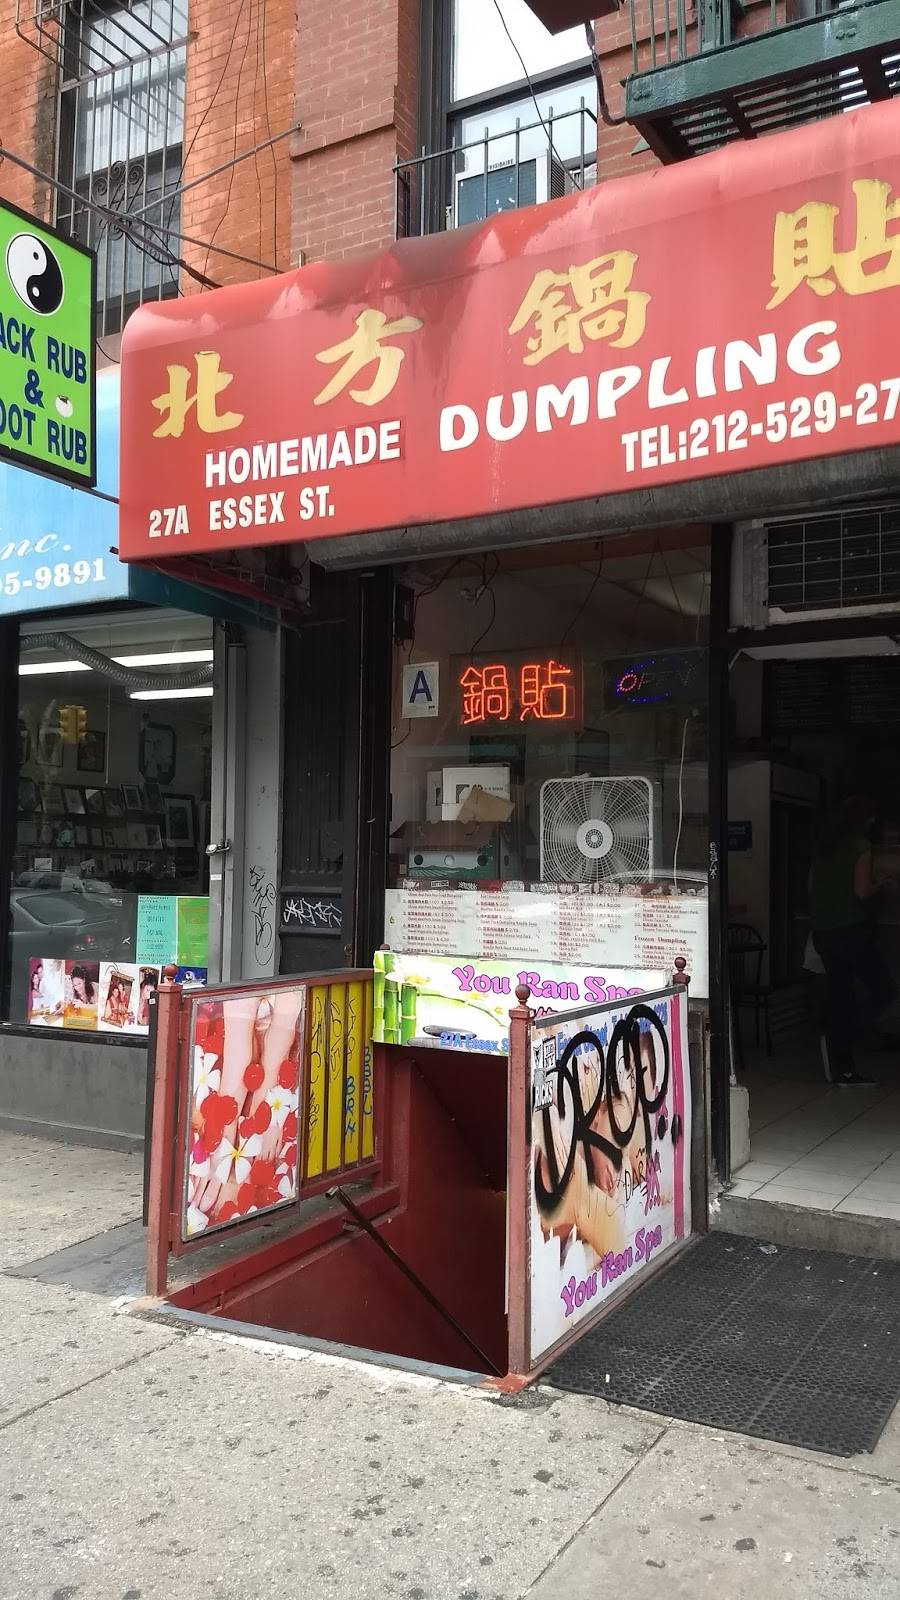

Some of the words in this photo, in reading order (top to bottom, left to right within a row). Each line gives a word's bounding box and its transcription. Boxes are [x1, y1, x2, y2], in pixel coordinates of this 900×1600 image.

[47, 335, 87, 385] RUB
[24, 369, 45, 409] &
[204, 420, 401, 488] HOMEMADE
[439, 320, 842, 452] DUMPLING
[47, 418, 87, 465] RUB
[148, 504, 190, 538] 27A
[208, 490, 285, 531] ESSEX
[299, 486, 335, 520] ST.
[0, 557, 106, 595] 5-9891
[408, 670, 433, 703] A
[460, 660, 571, 724] 鍋貼
[451, 964, 511, 994] You
[516, 970, 580, 1001] Ran
[559, 1275, 598, 1317] You
[599, 1250, 634, 1288] Ran
[634, 1224, 663, 1264] Spa
